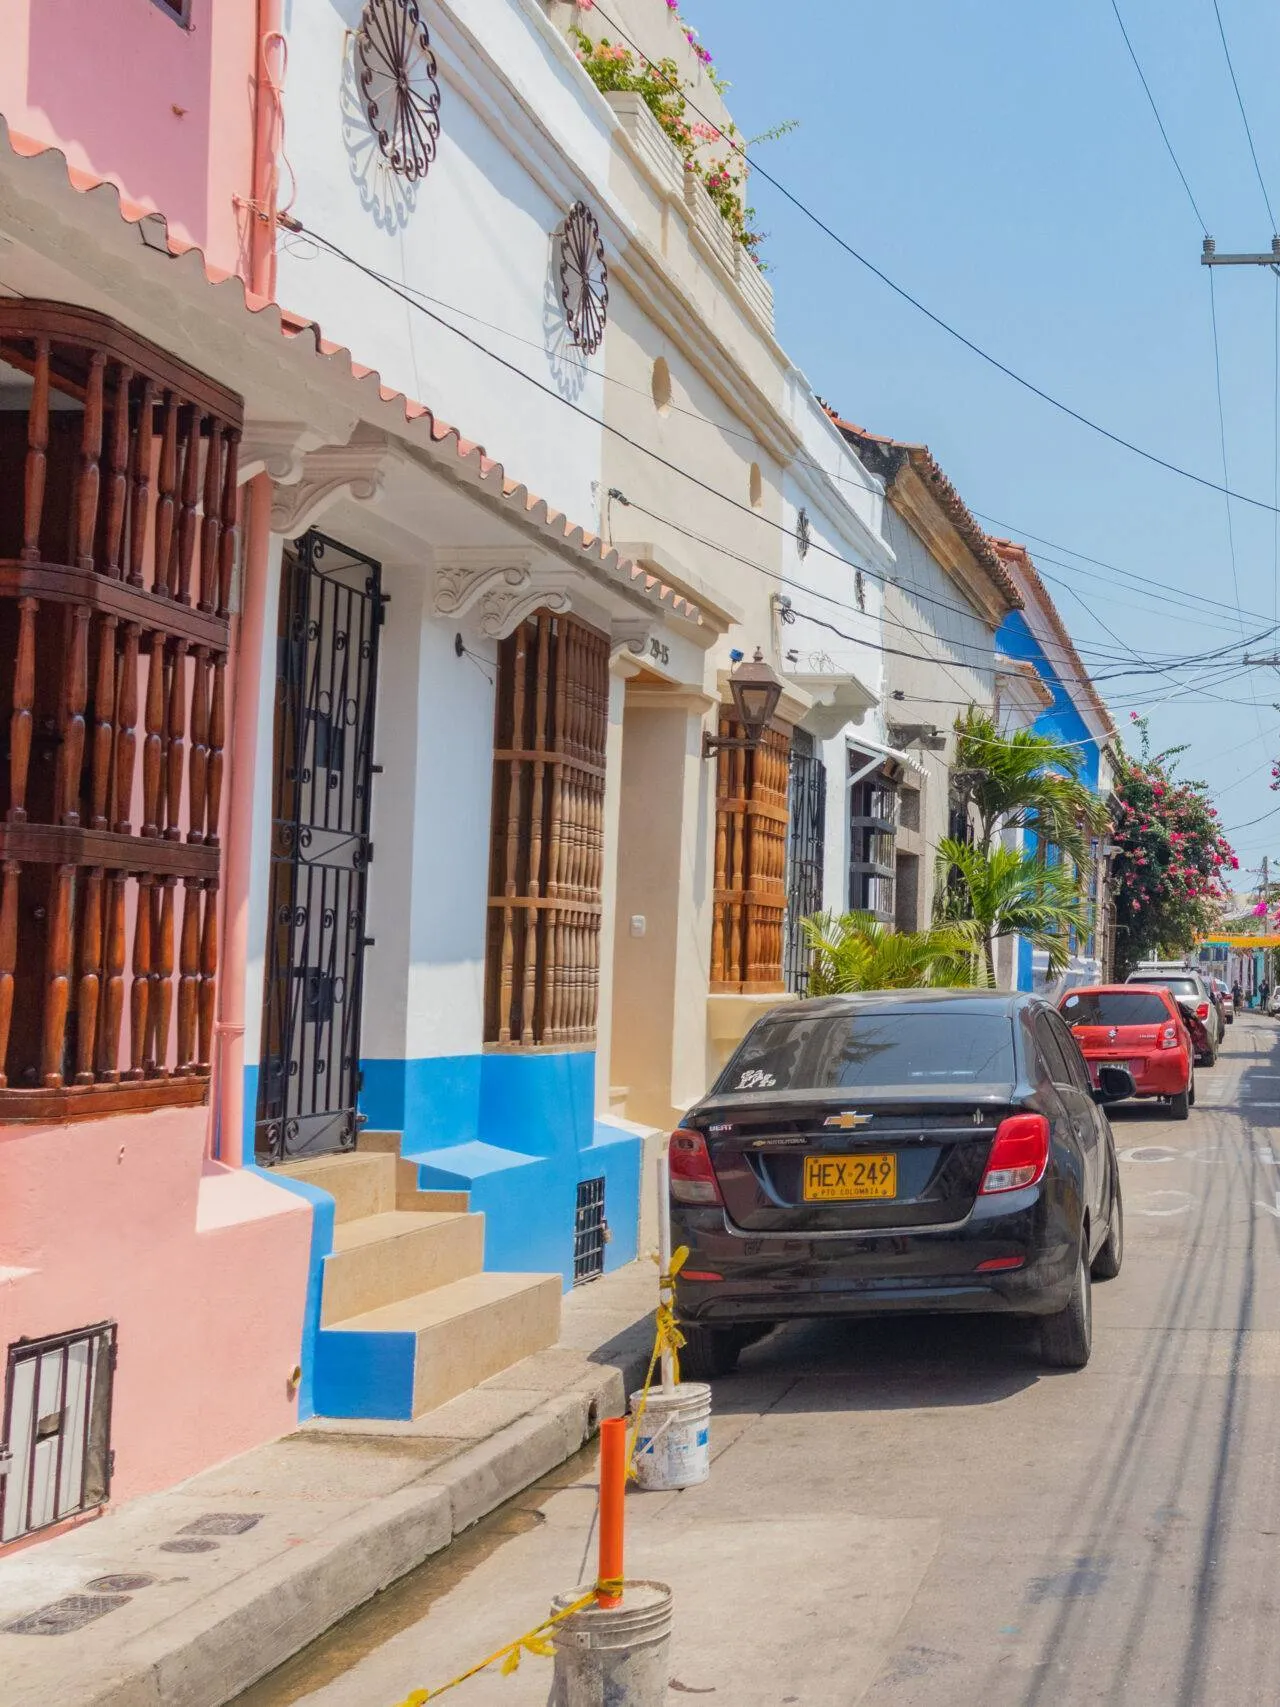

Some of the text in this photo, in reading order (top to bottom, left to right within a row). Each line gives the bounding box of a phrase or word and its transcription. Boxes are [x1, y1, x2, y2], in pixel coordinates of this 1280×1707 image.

[809, 1161, 892, 1187] HEX 249
[840, 1187, 879, 1196] COLOMBIA
